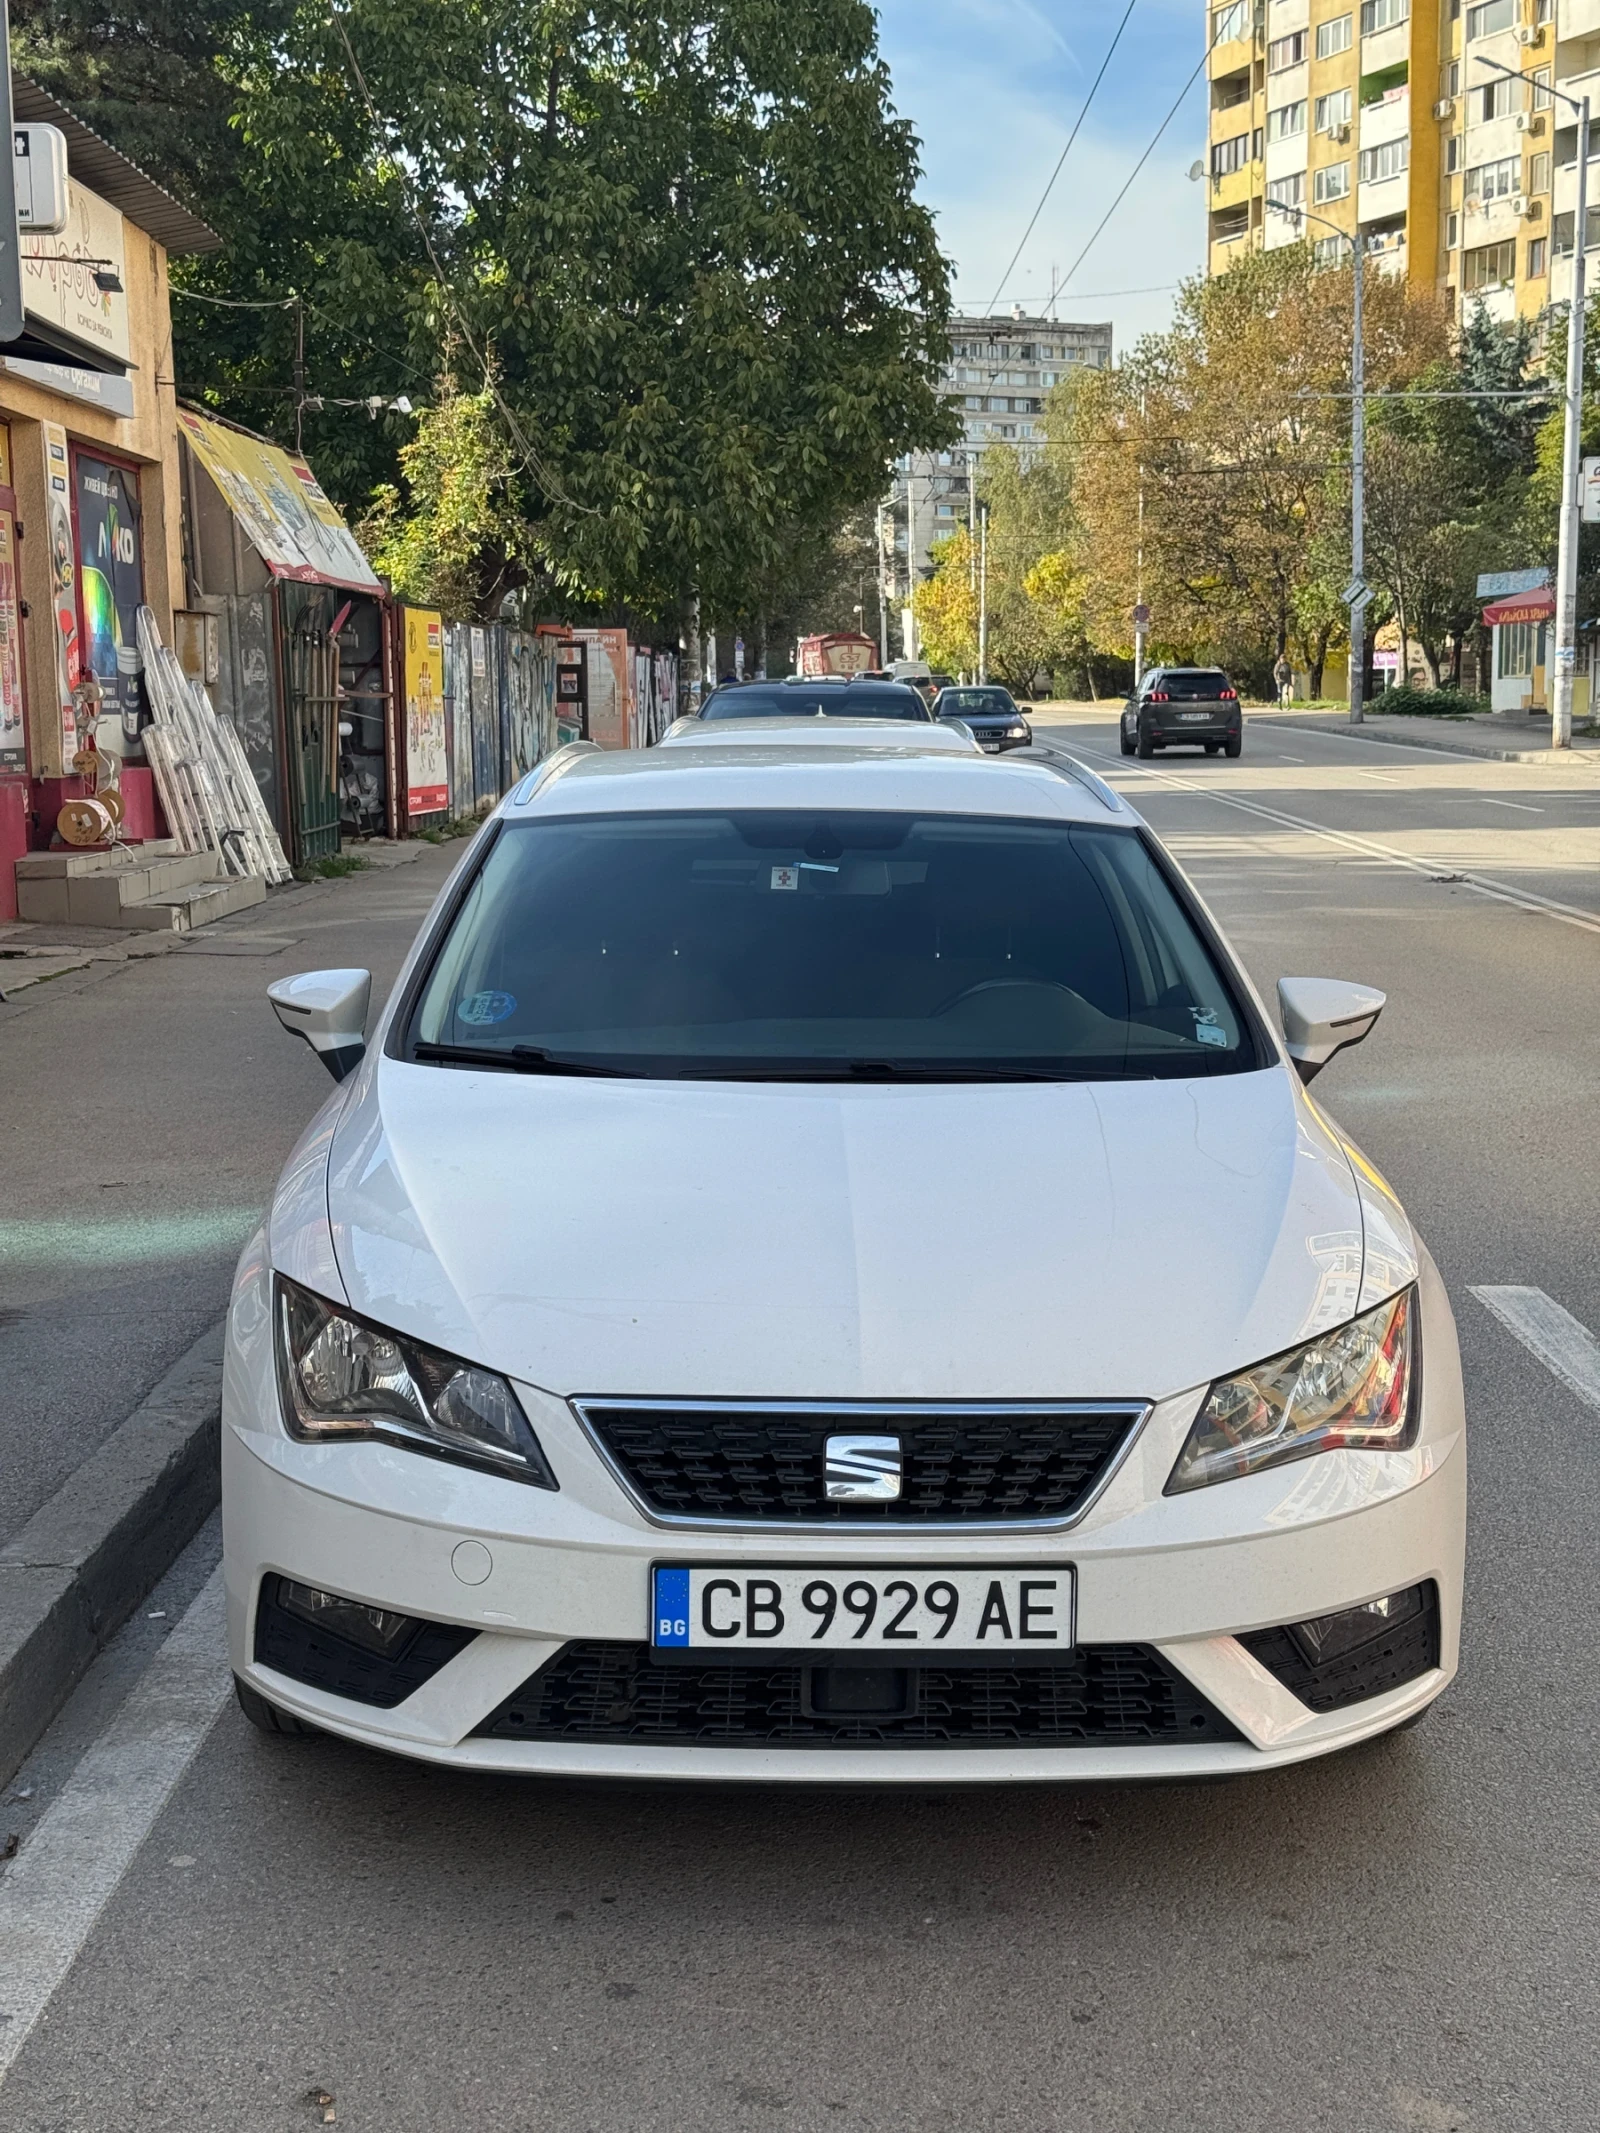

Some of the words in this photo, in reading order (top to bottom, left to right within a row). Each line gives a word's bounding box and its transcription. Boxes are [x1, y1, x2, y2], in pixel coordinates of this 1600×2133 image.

[84, 475, 100, 495] ЖИВЕЙ
[702, 1579, 785, 1638] CB
[801, 1580, 959, 1639] 9929
[976, 1580, 1058, 1639] AE
[659, 1619, 686, 1637] BG
